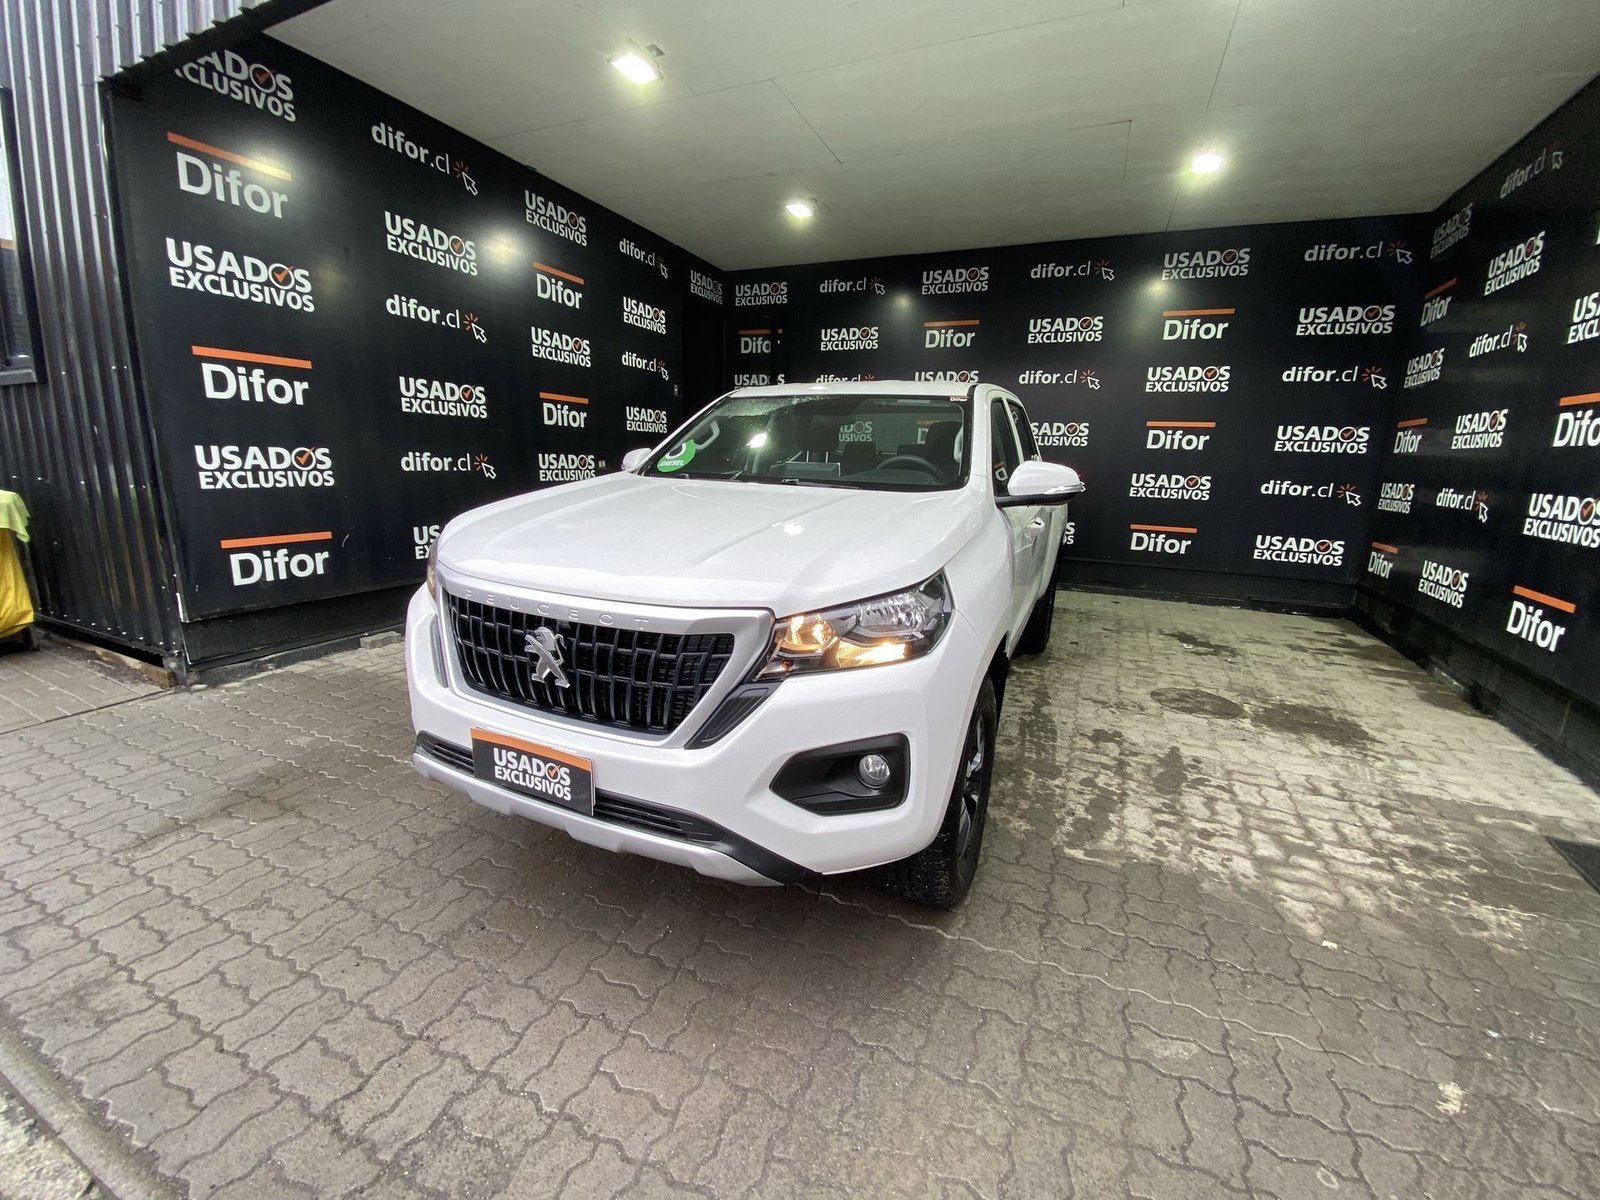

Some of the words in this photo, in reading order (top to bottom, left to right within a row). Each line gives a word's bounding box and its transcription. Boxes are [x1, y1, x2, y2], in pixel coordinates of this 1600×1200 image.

[198, 50, 293, 100] ADOS
[175, 62, 296, 123] CLUSIVOS
[371, 122, 450, 175] difor.cl
[176, 151, 288, 219] Difor
[1500, 147, 1547, 200] difor.cl
[524, 190, 586, 233] USADOS
[525, 208, 587, 247] EXCLUSIVOS
[1433, 202, 1473, 245] USADOS
[384, 211, 477, 260] USADOS
[387, 234, 478, 277] EXCLUSIVOS
[619, 238, 655, 267] difor.cl
[1164, 248, 1251, 268] USADOS
[1304, 241, 1383, 264] difor.cl
[1488, 230, 1546, 279] USADOS
[166, 237, 312, 294] USADOS
[922, 266, 989, 284] USADOS
[1030, 260, 1091, 279] difor.cl
[1161, 265, 1249, 281] EXCLUSIVOS
[1484, 255, 1541, 296] EXCLUSIVOS
[169, 266, 315, 313] EXCLUSIVOS
[536, 273, 582, 309] Difor
[690, 269, 723, 294] USADOS
[735, 281, 788, 297] USADOS
[819, 276, 867, 293] difor.cl
[921, 281, 989, 296] EXCLUSIVOS
[690, 282, 723, 305] EXCLUSIVOS
[735, 294, 788, 307] EXCLUSIVOS
[386, 294, 460, 329] difor.cl
[623, 296, 666, 323] USADOS
[1299, 304, 1396, 324] USADOS
[1420, 295, 1452, 327] Difor
[623, 311, 666, 335] EXCLUSIVOS
[821, 326, 879, 341] USADOS
[1028, 316, 1104, 333] USADOS
[1162, 319, 1229, 341] Difor
[1296, 320, 1393, 336] EXCLUSIVOS
[531, 327, 590, 355] USADOS
[740, 336, 780, 354] Difo
[820, 339, 879, 352] EXCLUSIVOS
[925, 328, 976, 349] Difor
[1027, 330, 1103, 344] EXCLUSIVOS
[1469, 324, 1513, 358] difor.cl
[532, 344, 591, 368] EXCLUSIVOS
[621, 352, 657, 372] difor.cl
[1407, 347, 1445, 375] USADOS
[201, 362, 309, 406] Difor
[734, 374, 785, 386] USADS
[914, 370, 979, 383] USADOS
[1018, 369, 1077, 385] difor.cl
[1147, 365, 1231, 381] USADOS
[1281, 366, 1359, 383] difor.cl
[1404, 366, 1441, 389] EXCLUSIVOS
[399, 376, 486, 404] USADOS
[1145, 379, 1229, 393] EXCLUSIVOS
[401, 396, 487, 419] EXCLUSIVOS
[543, 402, 587, 428] Difor
[626, 406, 667, 423] USADOS
[626, 421, 667, 434] EXCLUSIVOS
[1031, 422, 1090, 436] SADOS
[1455, 408, 1509, 434] USADOS
[1552, 409, 1600, 448] Difo
[1033, 436, 1089, 447] LUSIVOS
[1146, 429, 1210, 451] Difor
[1276, 425, 1371, 443] USADOS
[1393, 430, 1423, 454] Difor
[1451, 432, 1504, 450] EXCLUSIVOS
[194, 444, 332, 470] USADOS
[1273, 440, 1368, 455] EXCLUSIVOS
[401, 452, 471, 472] difor.cl
[538, 453, 595, 469] USADOS
[199, 469, 334, 490] EXCLUSIVOS
[539, 469, 596, 481] EXCLUSIVOS
[1131, 473, 1212, 490] USADOS
[1129, 486, 1211, 502] EXCLUSIVOS
[1260, 479, 1334, 499] difor.cl
[1381, 482, 1415, 500] USADOS
[1436, 488, 1477, 511] difor.cl
[1378, 498, 1412, 515] EXCLUSIVOS
[1130, 532, 1192, 555] Difor
[1255, 534, 1345, 556] USADOS
[229, 548, 330, 586] Difor
[1253, 548, 1343, 567] EXCLUSIVOS
[1367, 551, 1394, 579] Difor
[1421, 559, 1470, 593] USADOS
[1417, 581, 1465, 609] EXCLUSIVOS
[1506, 600, 1566, 653] Difor
[493, 747, 571, 785] USADOS
[494, 765, 571, 801] EXCLUSIVOS
